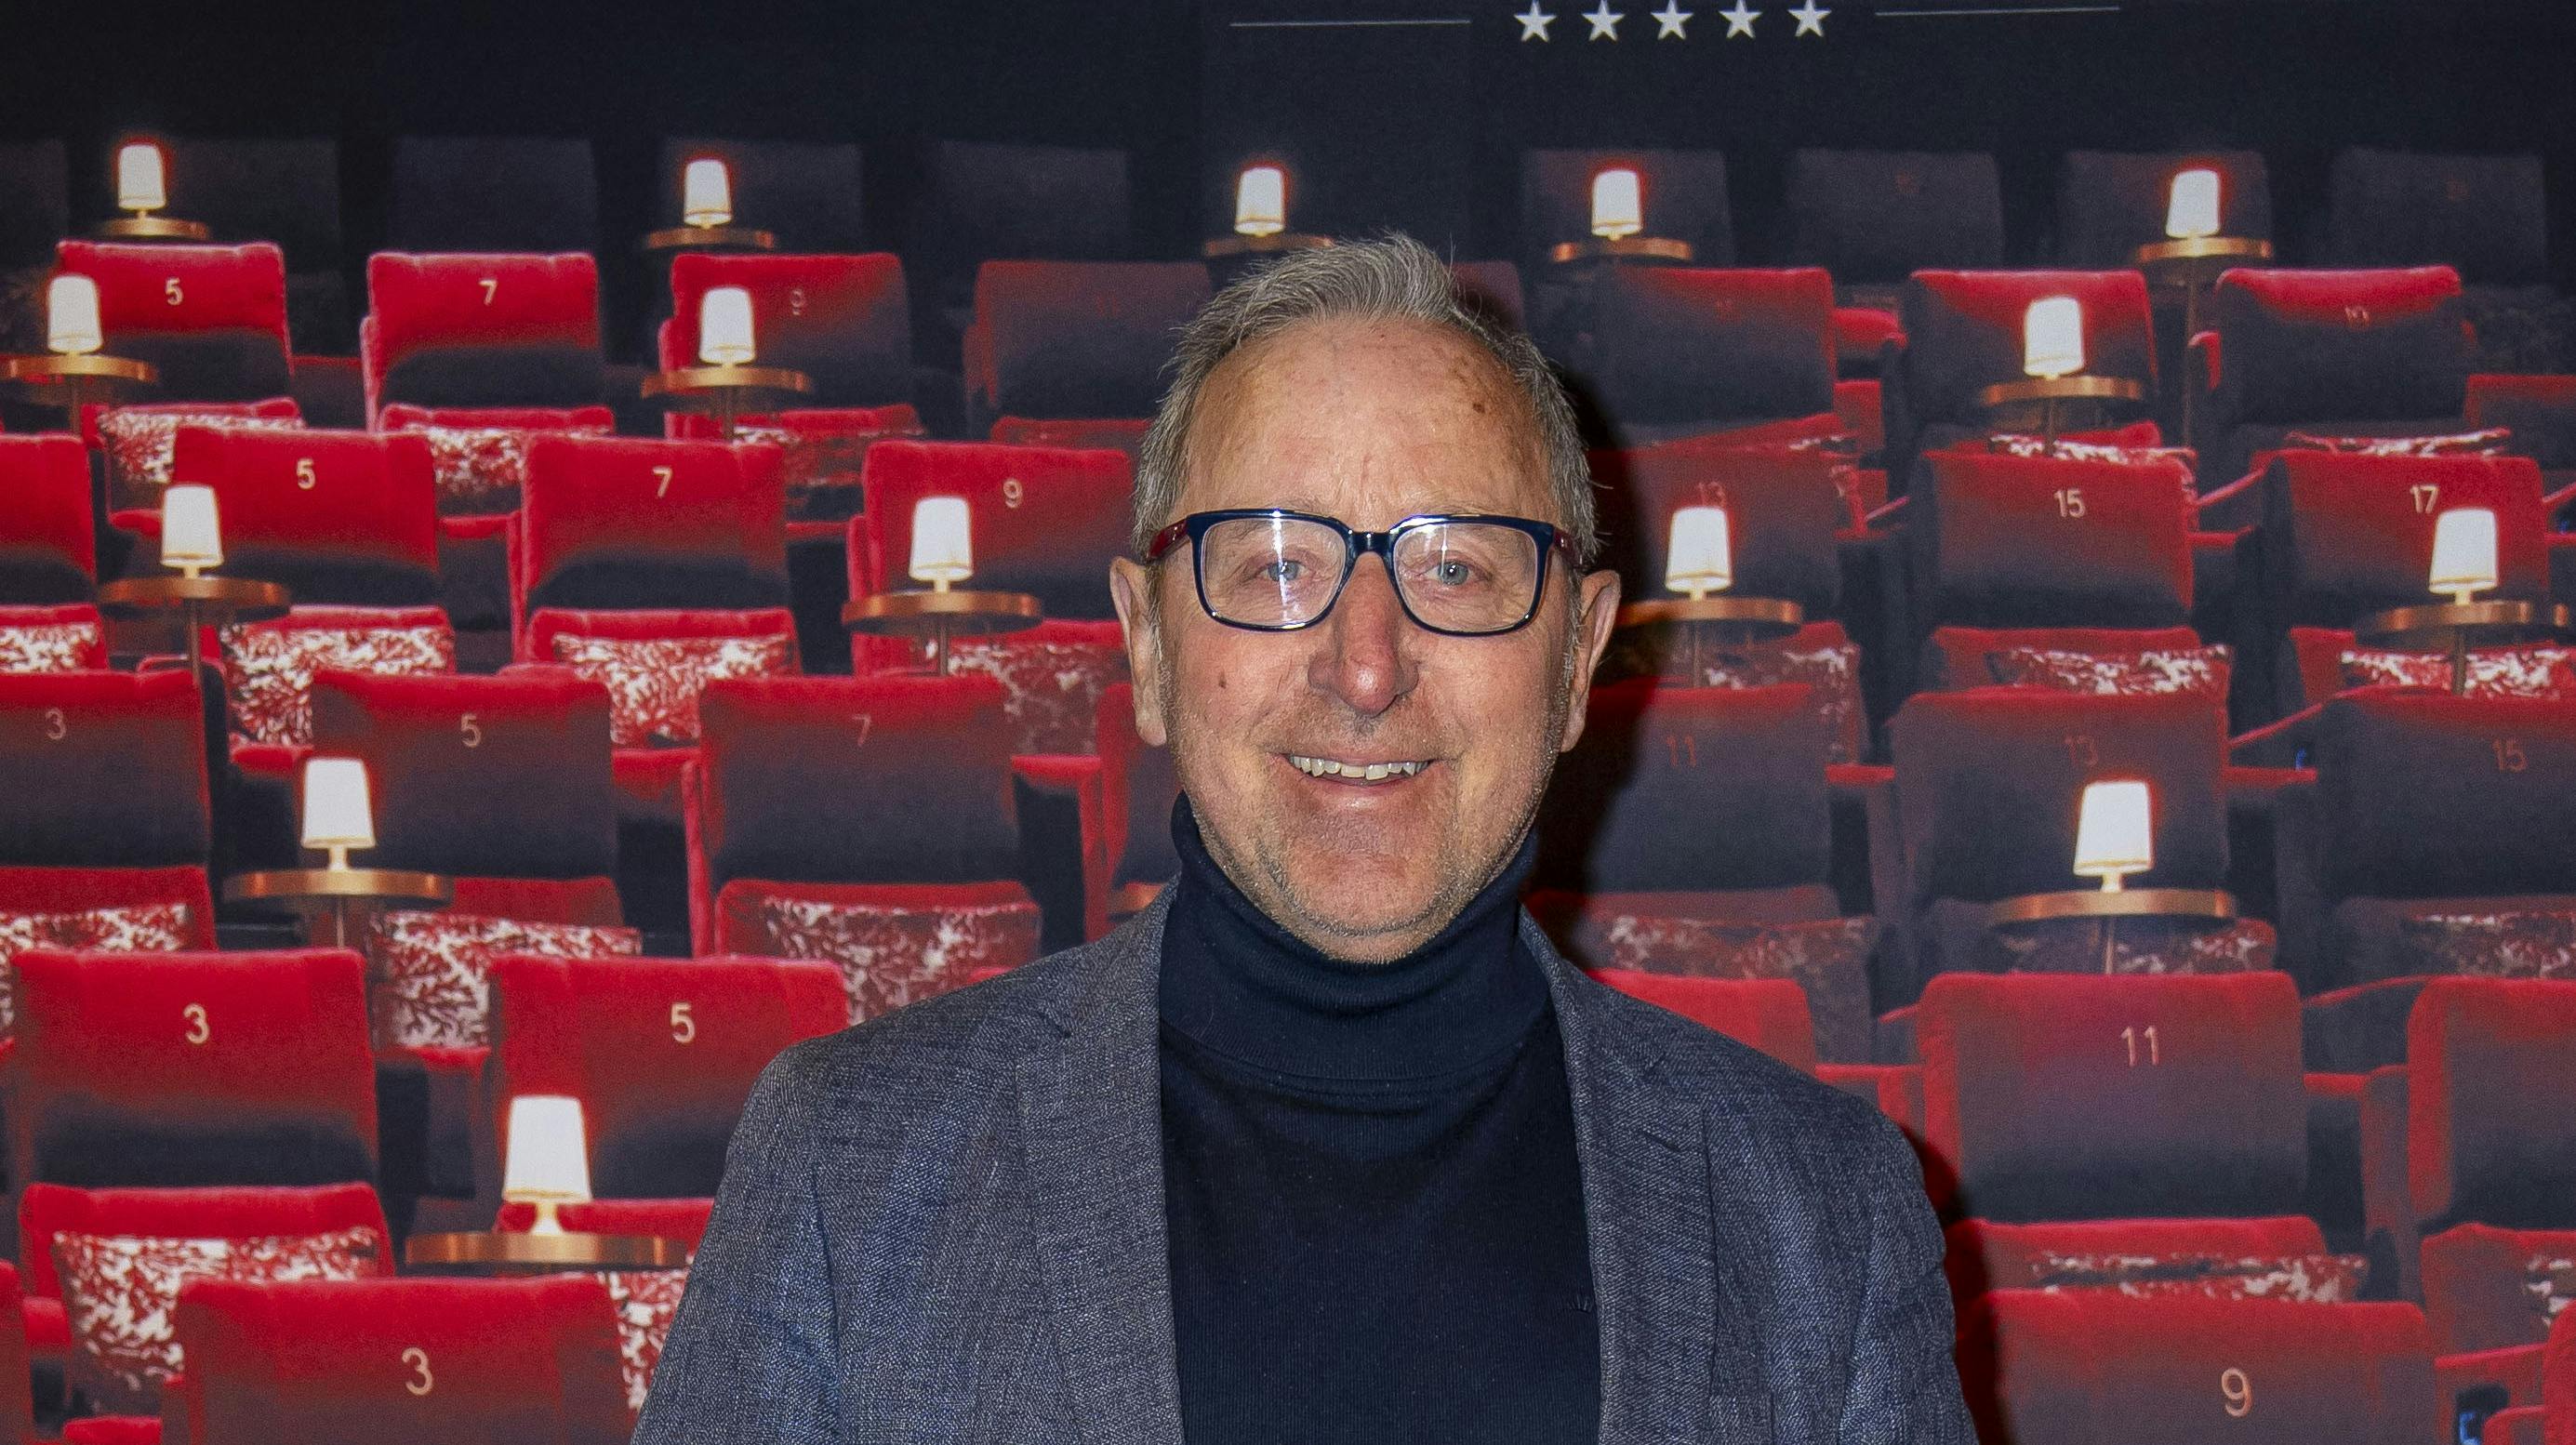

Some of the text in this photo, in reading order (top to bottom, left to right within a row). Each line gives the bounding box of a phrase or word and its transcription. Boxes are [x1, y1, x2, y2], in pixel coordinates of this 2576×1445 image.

[165, 276, 184, 306] 5
[478, 277, 498, 306] 7
[296, 457, 316, 490] 5
[652, 466, 672, 498] 7
[1003, 477, 1023, 509] 9
[2053, 487, 2087, 519] 15
[2409, 484, 2439, 514] 17
[45, 708, 67, 740] 3
[460, 712, 482, 748] 5
[851, 713, 871, 747] 7
[1666, 735, 1697, 768] 11
[2492, 738, 2529, 774] 15
[183, 1002, 210, 1044] 3
[671, 1001, 696, 1043] 5
[2120, 1026, 2159, 1067] 11
[402, 1346, 433, 1396] 3
[2220, 1367, 2253, 1418] 9
